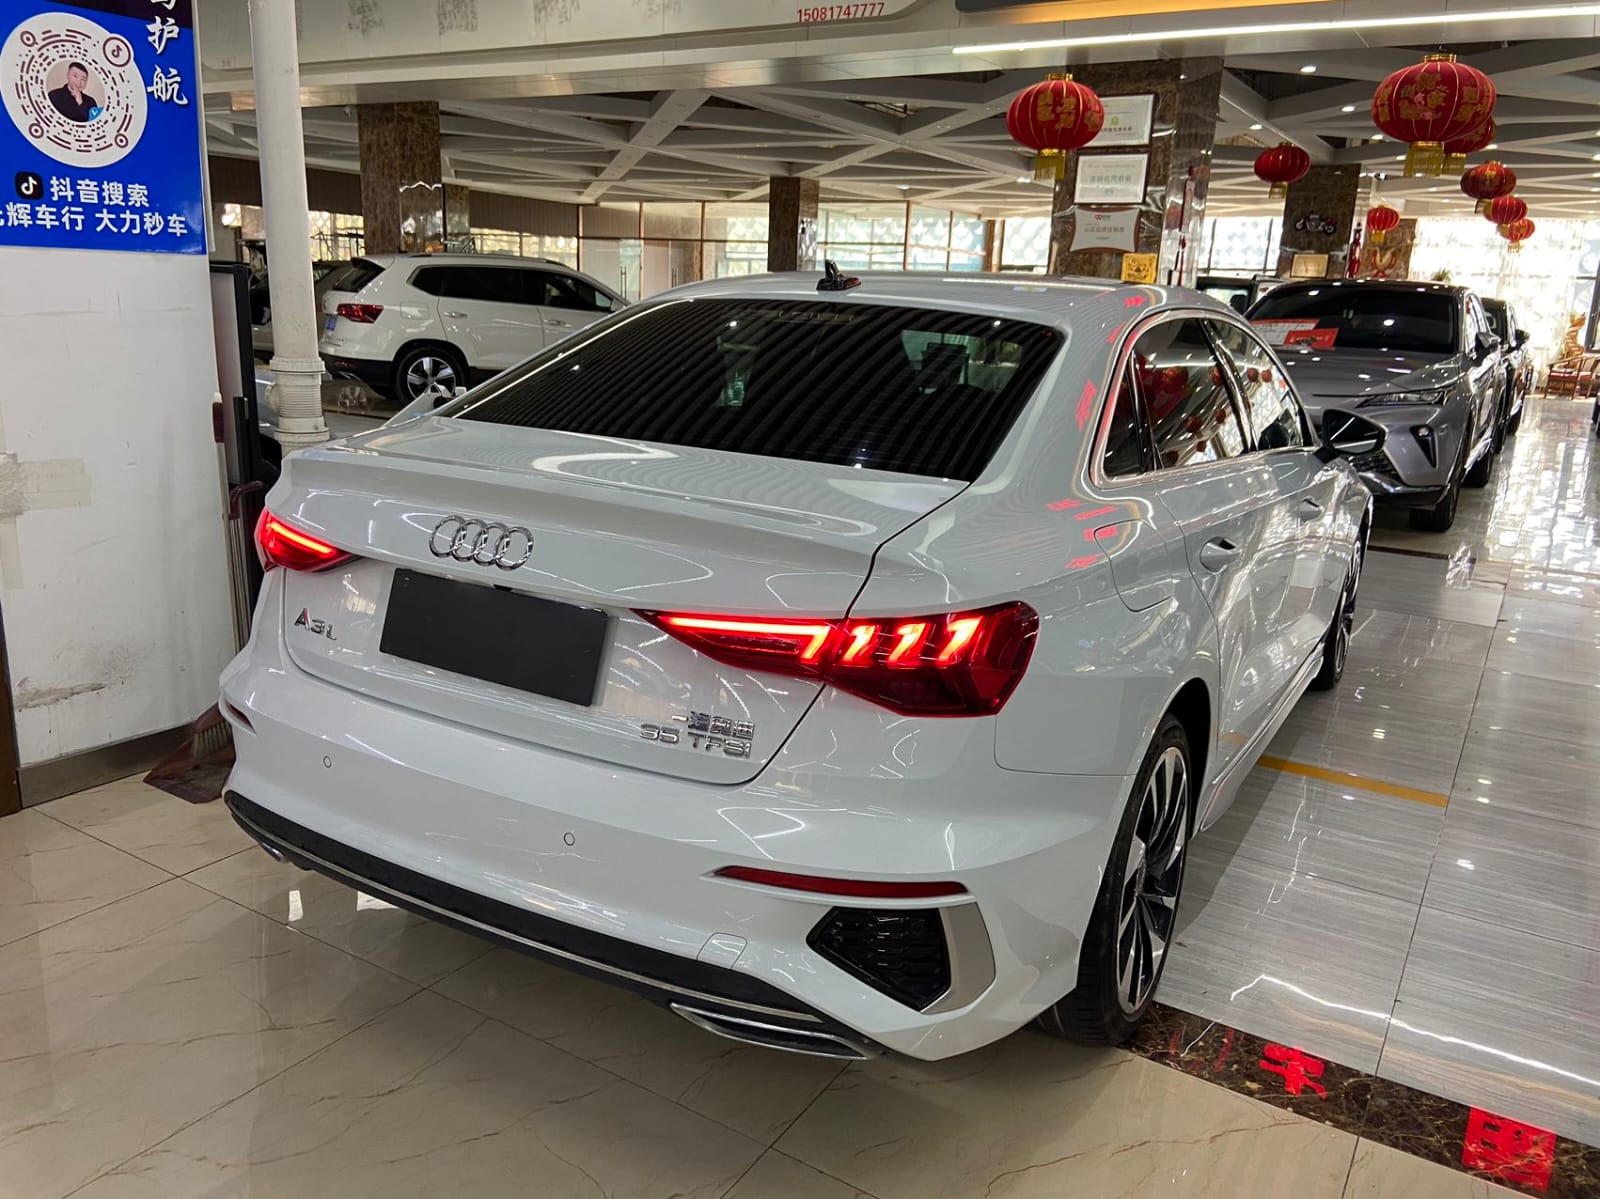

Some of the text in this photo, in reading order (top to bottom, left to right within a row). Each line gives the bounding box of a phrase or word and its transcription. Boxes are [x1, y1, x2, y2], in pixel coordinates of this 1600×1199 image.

[797, 2, 885, 23] 15081747777
[50, 176, 150, 208] 抖音搜索
[95, 208, 188, 237] 大力秒车
[294, 607, 337, 641] A3L
[640, 723, 752, 759] 35 TFSI
